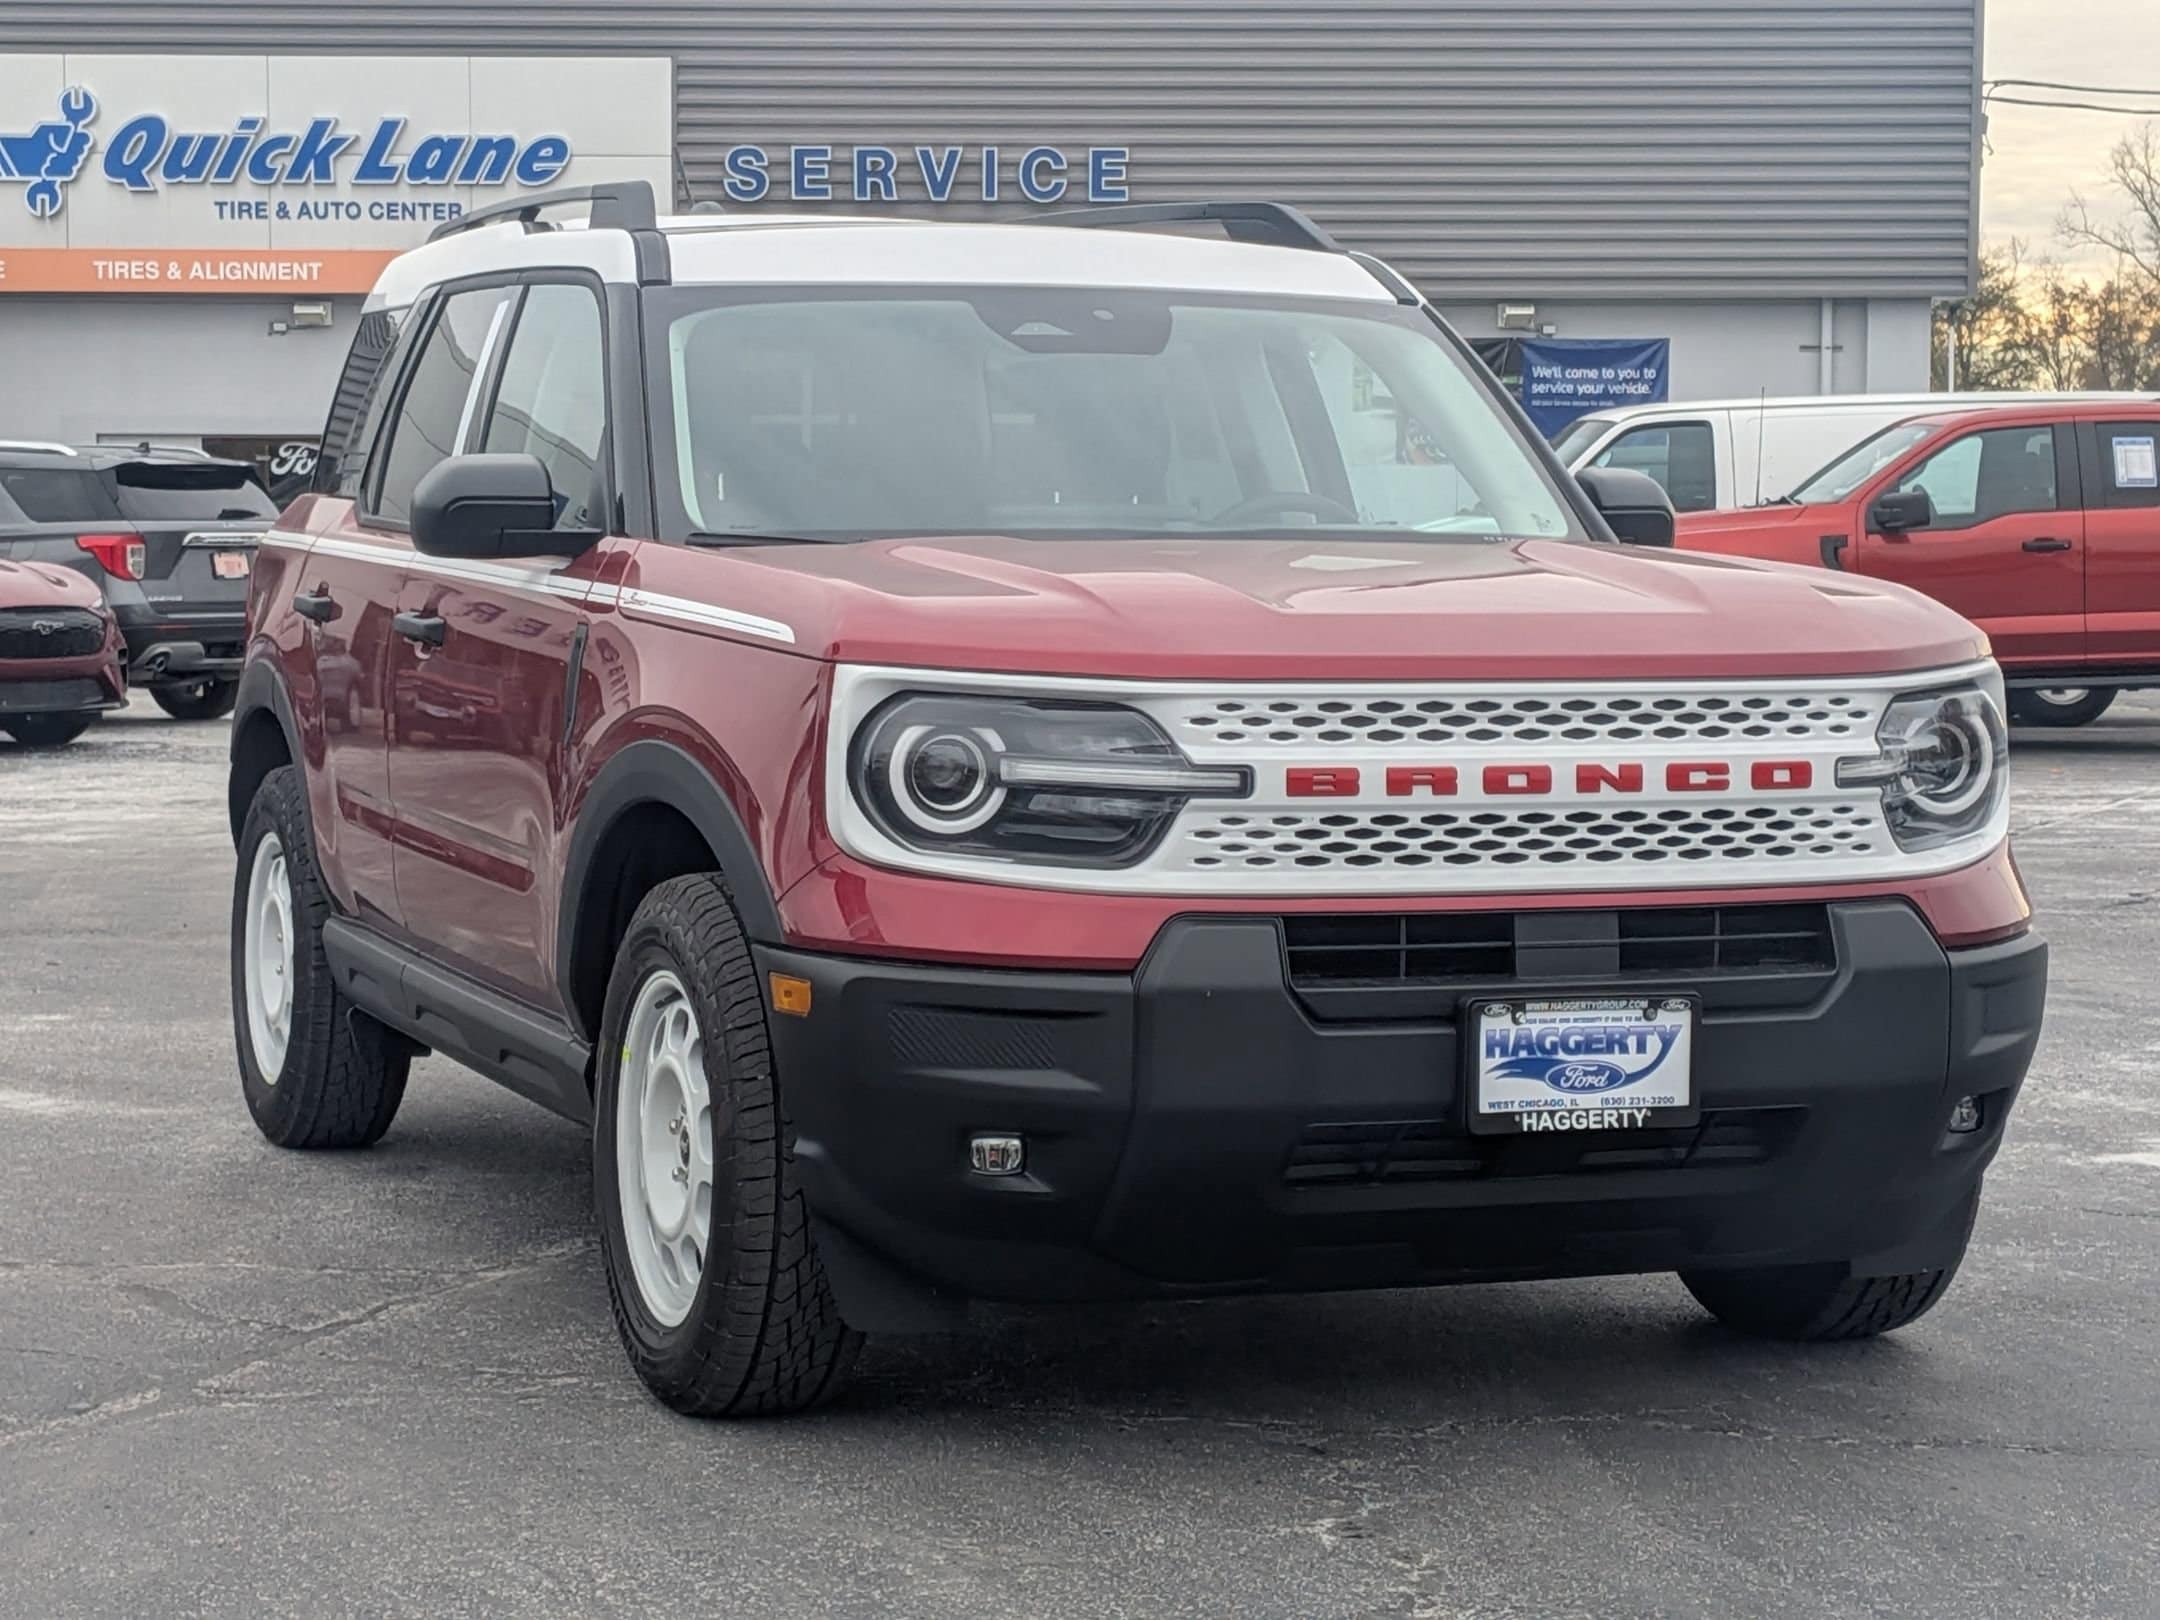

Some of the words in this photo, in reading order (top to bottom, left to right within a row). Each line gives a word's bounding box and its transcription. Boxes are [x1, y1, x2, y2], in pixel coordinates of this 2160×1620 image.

[103, 114, 357, 191] Quick
[351, 116, 571, 186] Lane
[723, 145, 1130, 202] SERVICE
[215, 201, 268, 219] TIRE
[275, 201, 291, 219] &
[297, 201, 361, 220] AUTO
[368, 202, 462, 220] CENTER
[93, 261, 159, 279] TIRES
[167, 261, 182, 280] &
[189, 262, 322, 280] ALIGNMENT
[1531, 366, 1562, 379] We'll
[1565, 368, 1599, 379] come
[1602, 368, 1615, 379] to
[1617, 369, 1641, 381] you
[1644, 368, 1656, 379] to
[1531, 382, 1574, 394] service
[1576, 383, 1604, 396] your
[1286, 761, 1813, 797] BRONCO
[1485, 1024, 1682, 1059] HAGGERTY
[1560, 1065, 1610, 1089] Ford
[1488, 1101, 1514, 1110] WEST
[1518, 1098, 1567, 1109] CHICAGO,
[1570, 1098, 1579, 1106] IL
[1600, 1096, 1626, 1106] (630)
[1629, 1095, 1675, 1105] 231-3200
[1522, 1109, 1647, 1132] HAGGERTY
